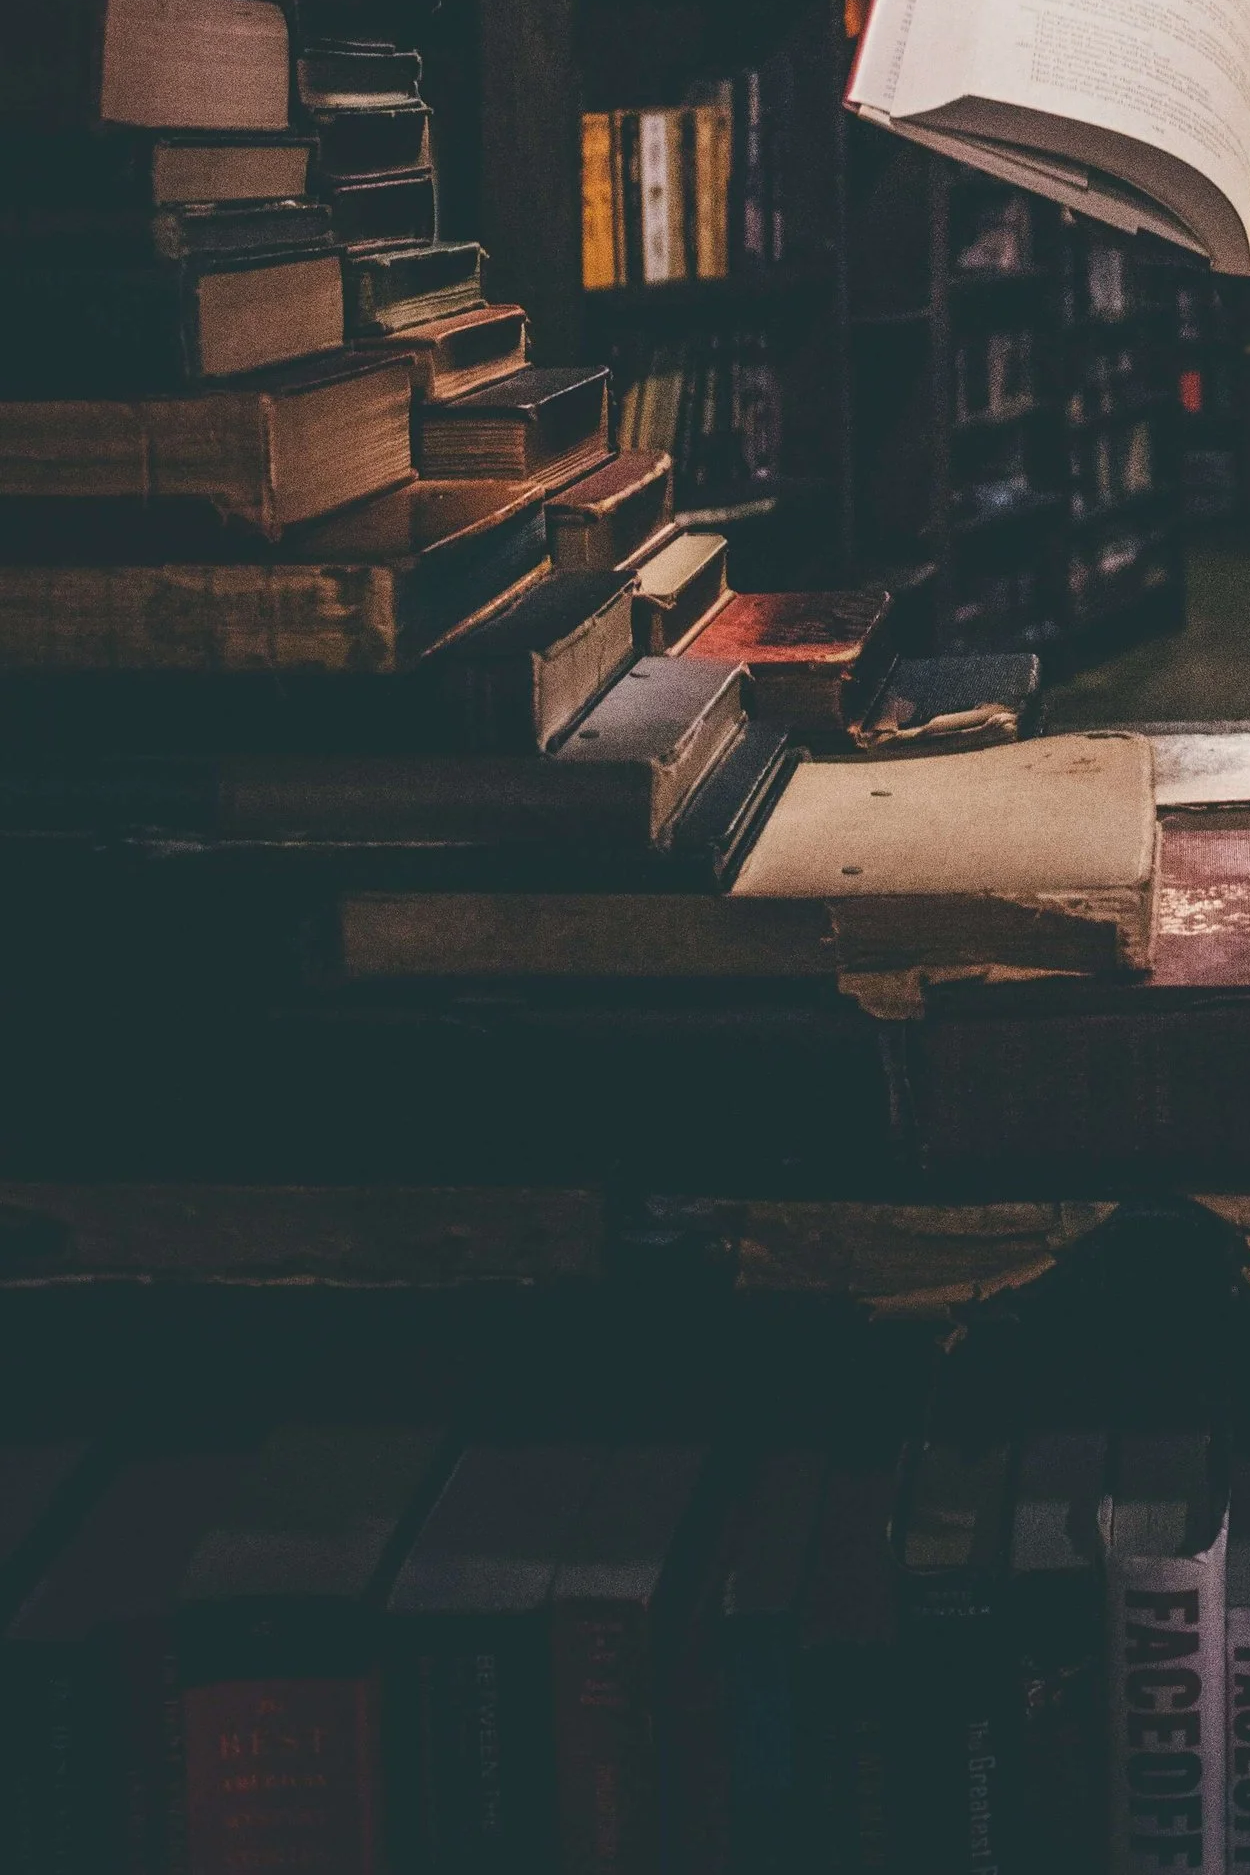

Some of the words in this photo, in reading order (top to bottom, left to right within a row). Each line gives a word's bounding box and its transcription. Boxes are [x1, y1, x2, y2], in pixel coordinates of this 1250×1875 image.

[966, 1719, 990, 1753] The
[1123, 1587, 1204, 1870] FACEOFF
[966, 1754, 997, 1859] Greatest
